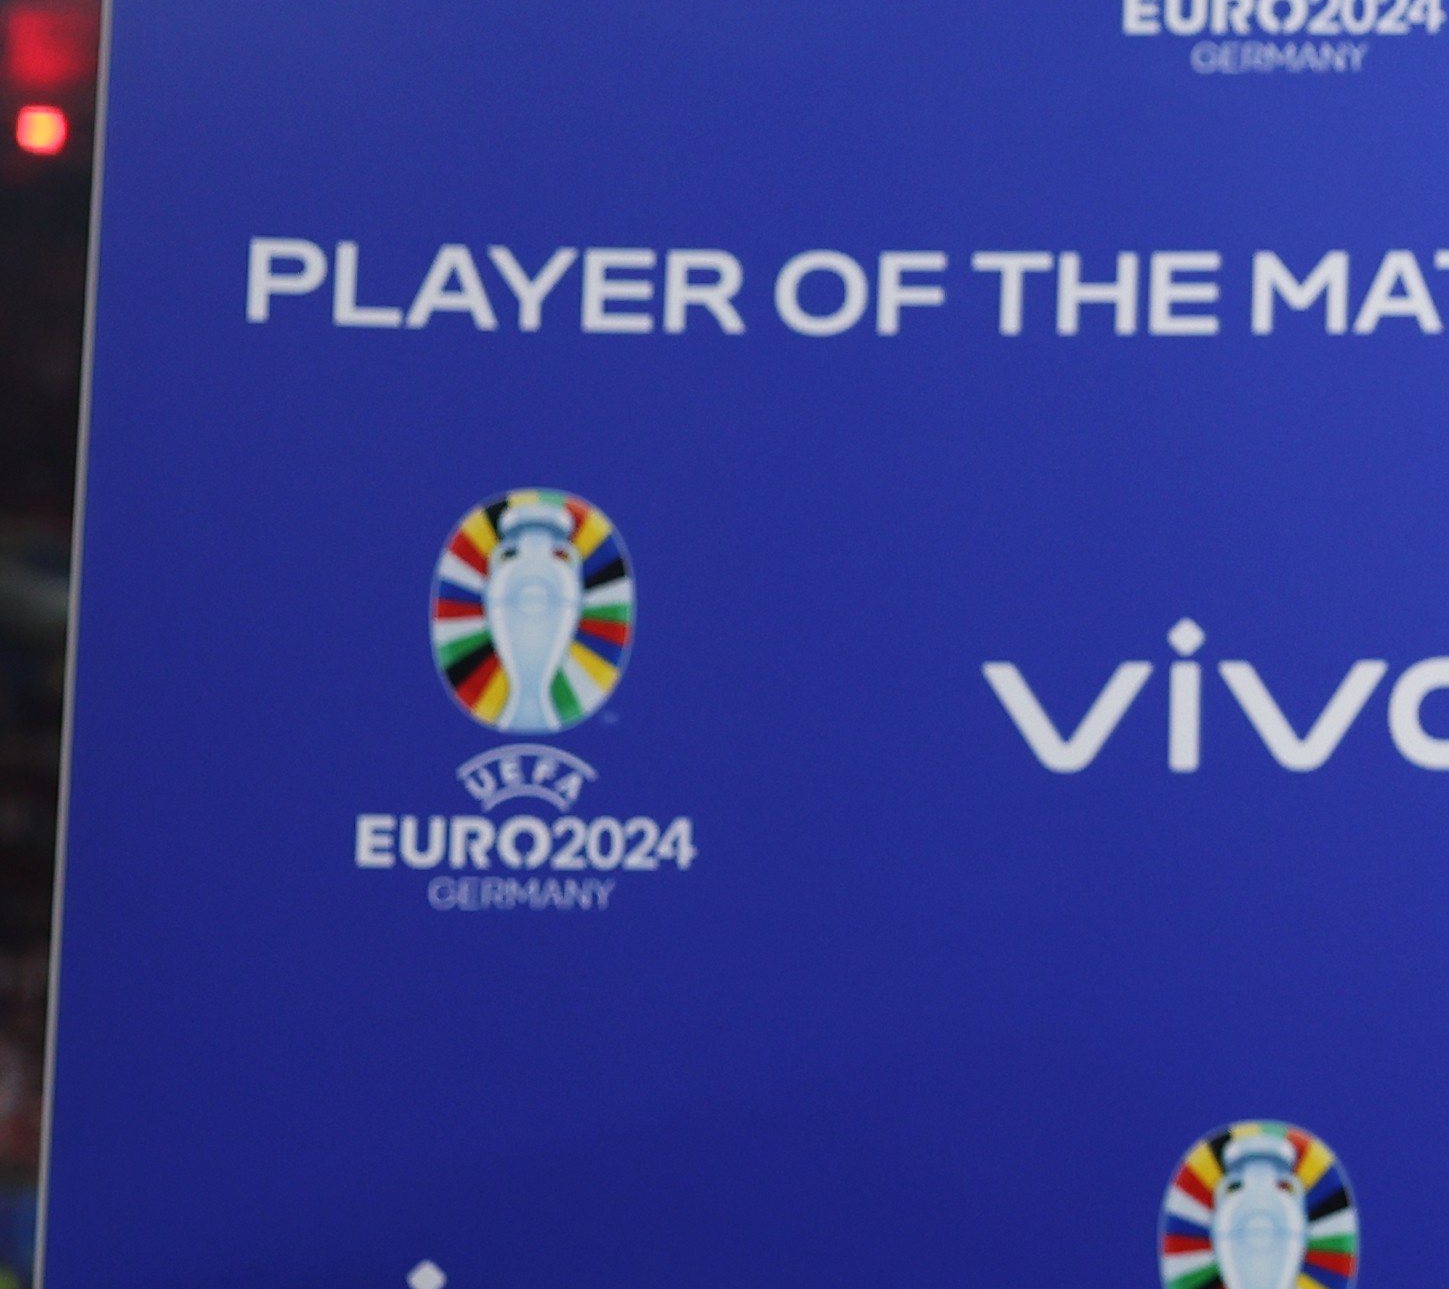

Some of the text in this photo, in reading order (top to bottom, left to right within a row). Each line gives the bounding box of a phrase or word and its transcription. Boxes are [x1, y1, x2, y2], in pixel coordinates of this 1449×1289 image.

[1190, 41, 1368, 74] GERMANY
[246, 237, 746, 335] PLAYER
[774, 249, 948, 337] OF
[971, 251, 1221, 336] THE
[464, 756, 582, 801] UEFA
[428, 876, 615, 911] GERMANY
